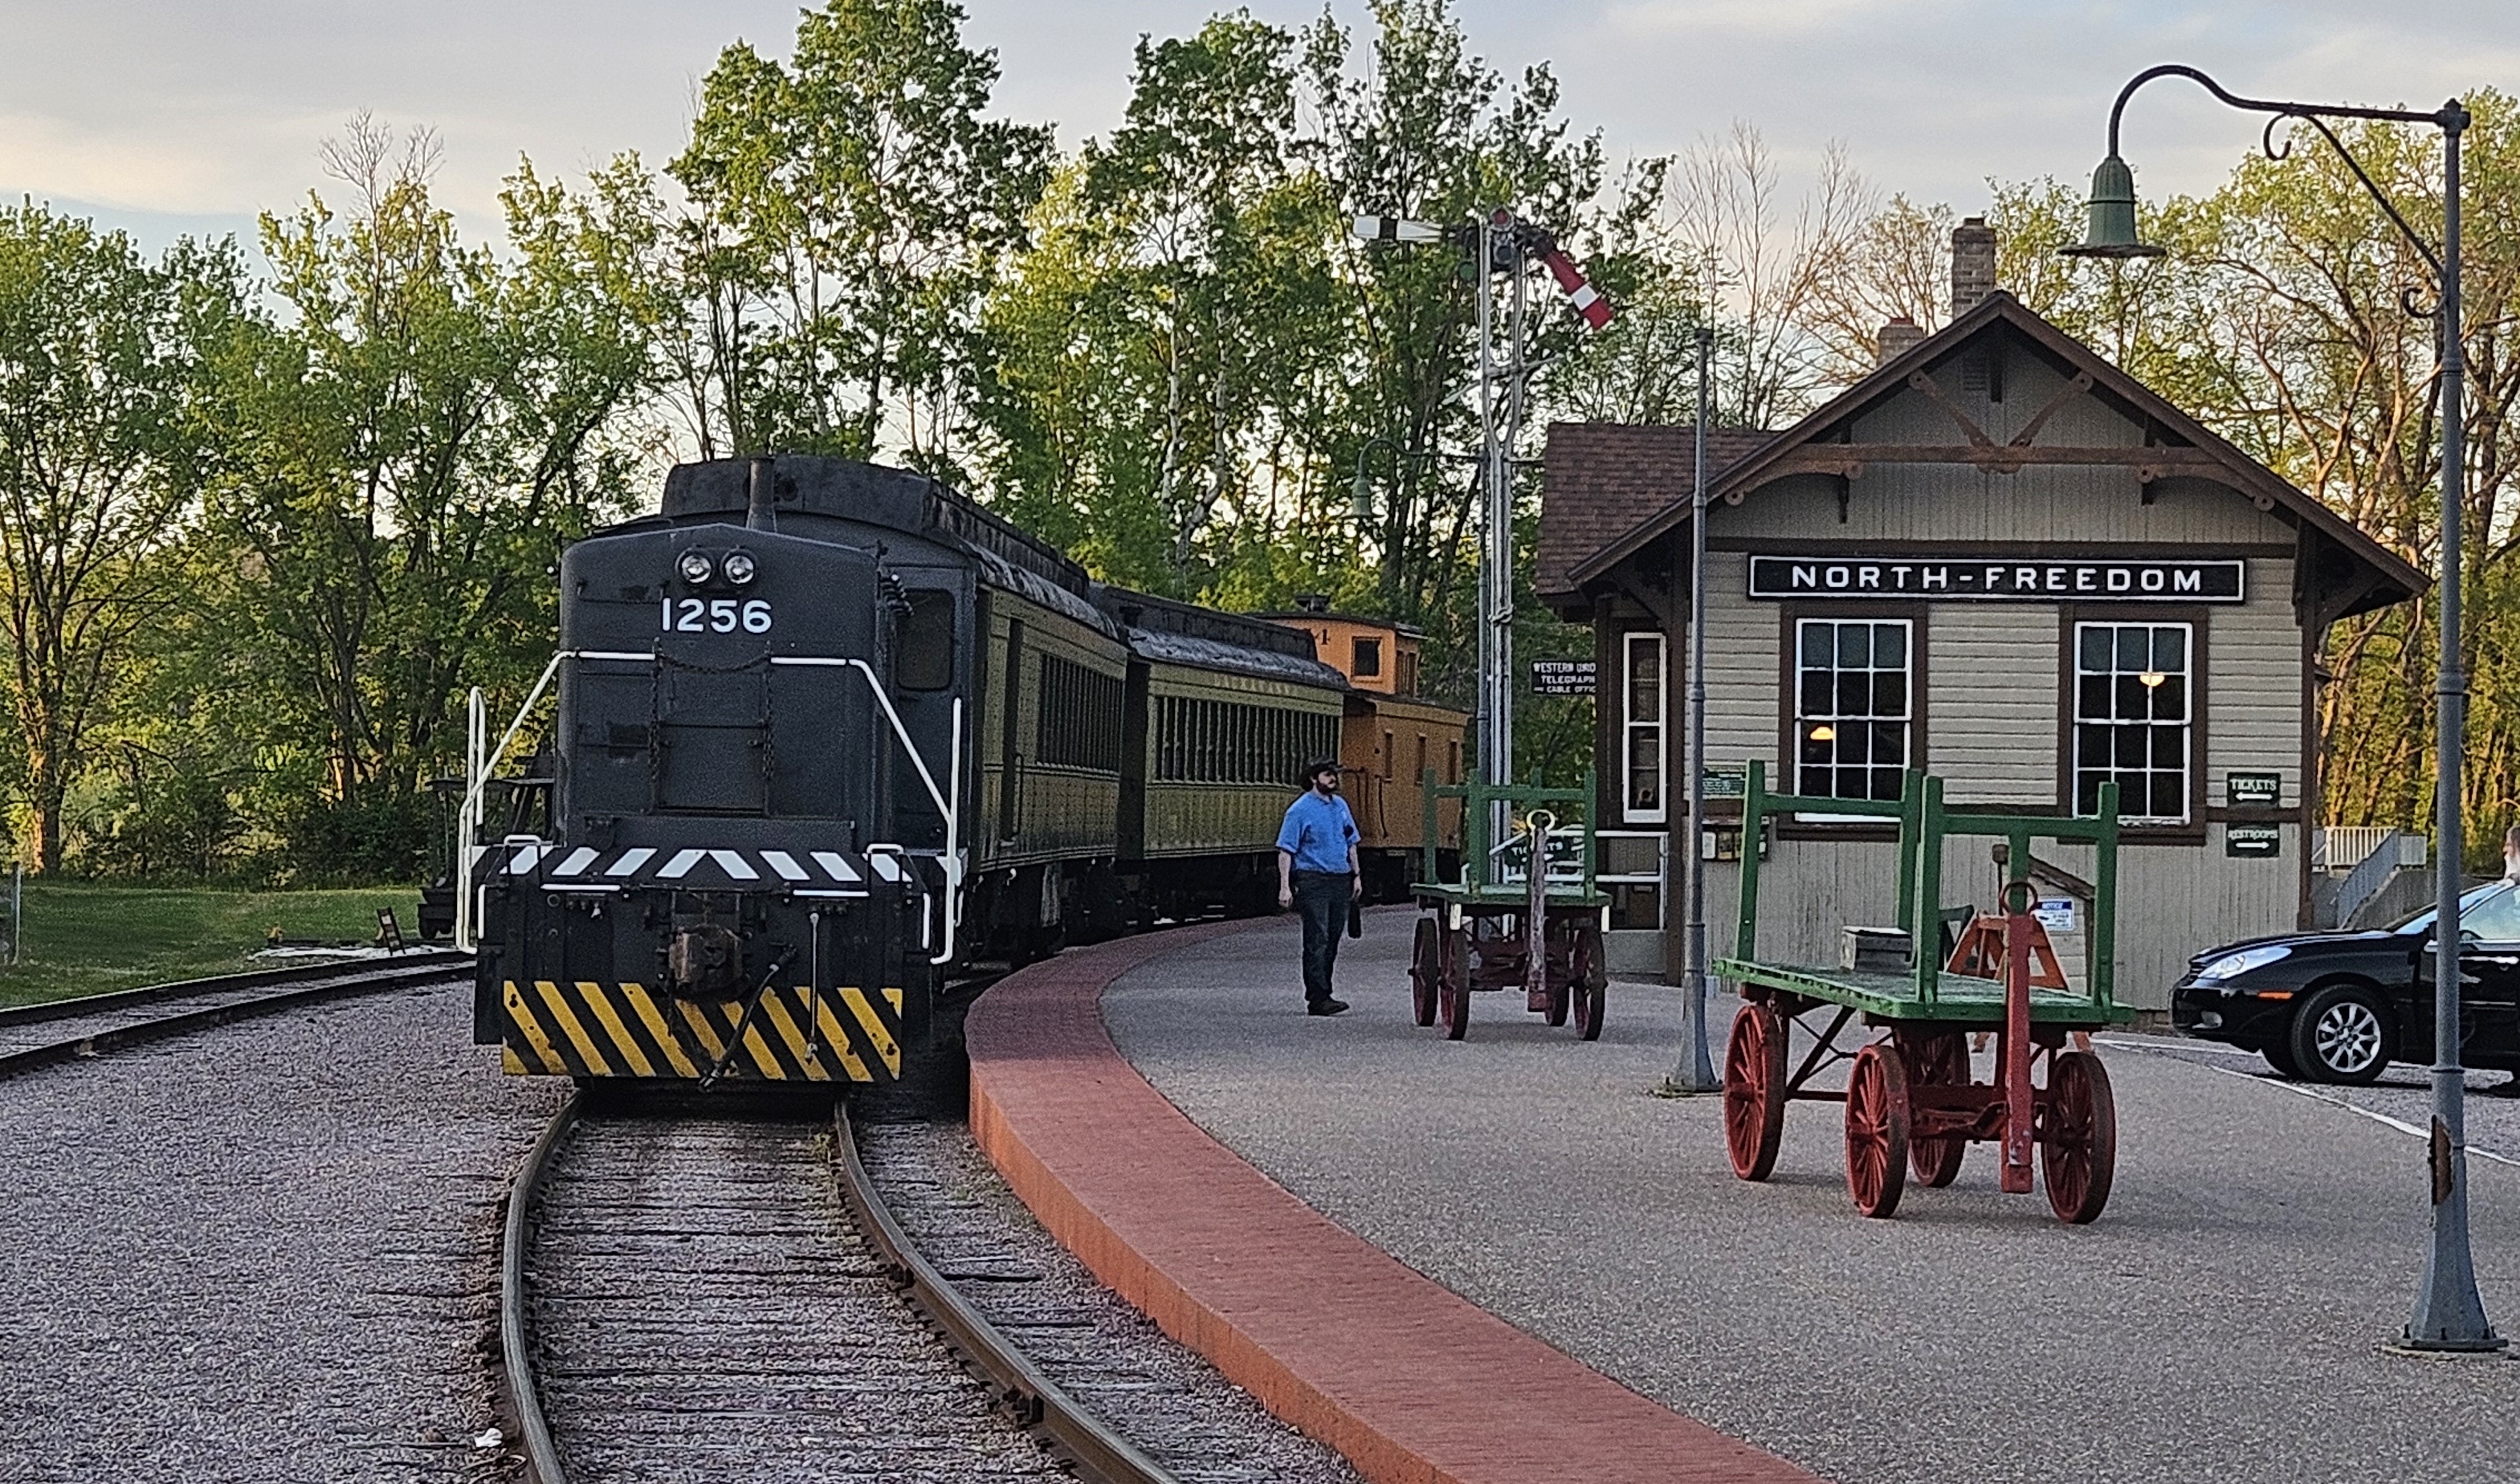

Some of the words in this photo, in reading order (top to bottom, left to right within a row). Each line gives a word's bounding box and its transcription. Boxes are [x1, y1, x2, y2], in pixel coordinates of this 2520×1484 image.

[1792, 565, 2201, 592] NORTH-FREEDOM
[662, 597, 772, 634] 1256
[1533, 662, 1574, 673] WESTERN
[1576, 662, 1596, 673] UNIO
[1541, 675, 1596, 684] TELEGRAPH
[1574, 685, 1596, 693] OFFIC
[2229, 777, 2277, 793] TICKETS
